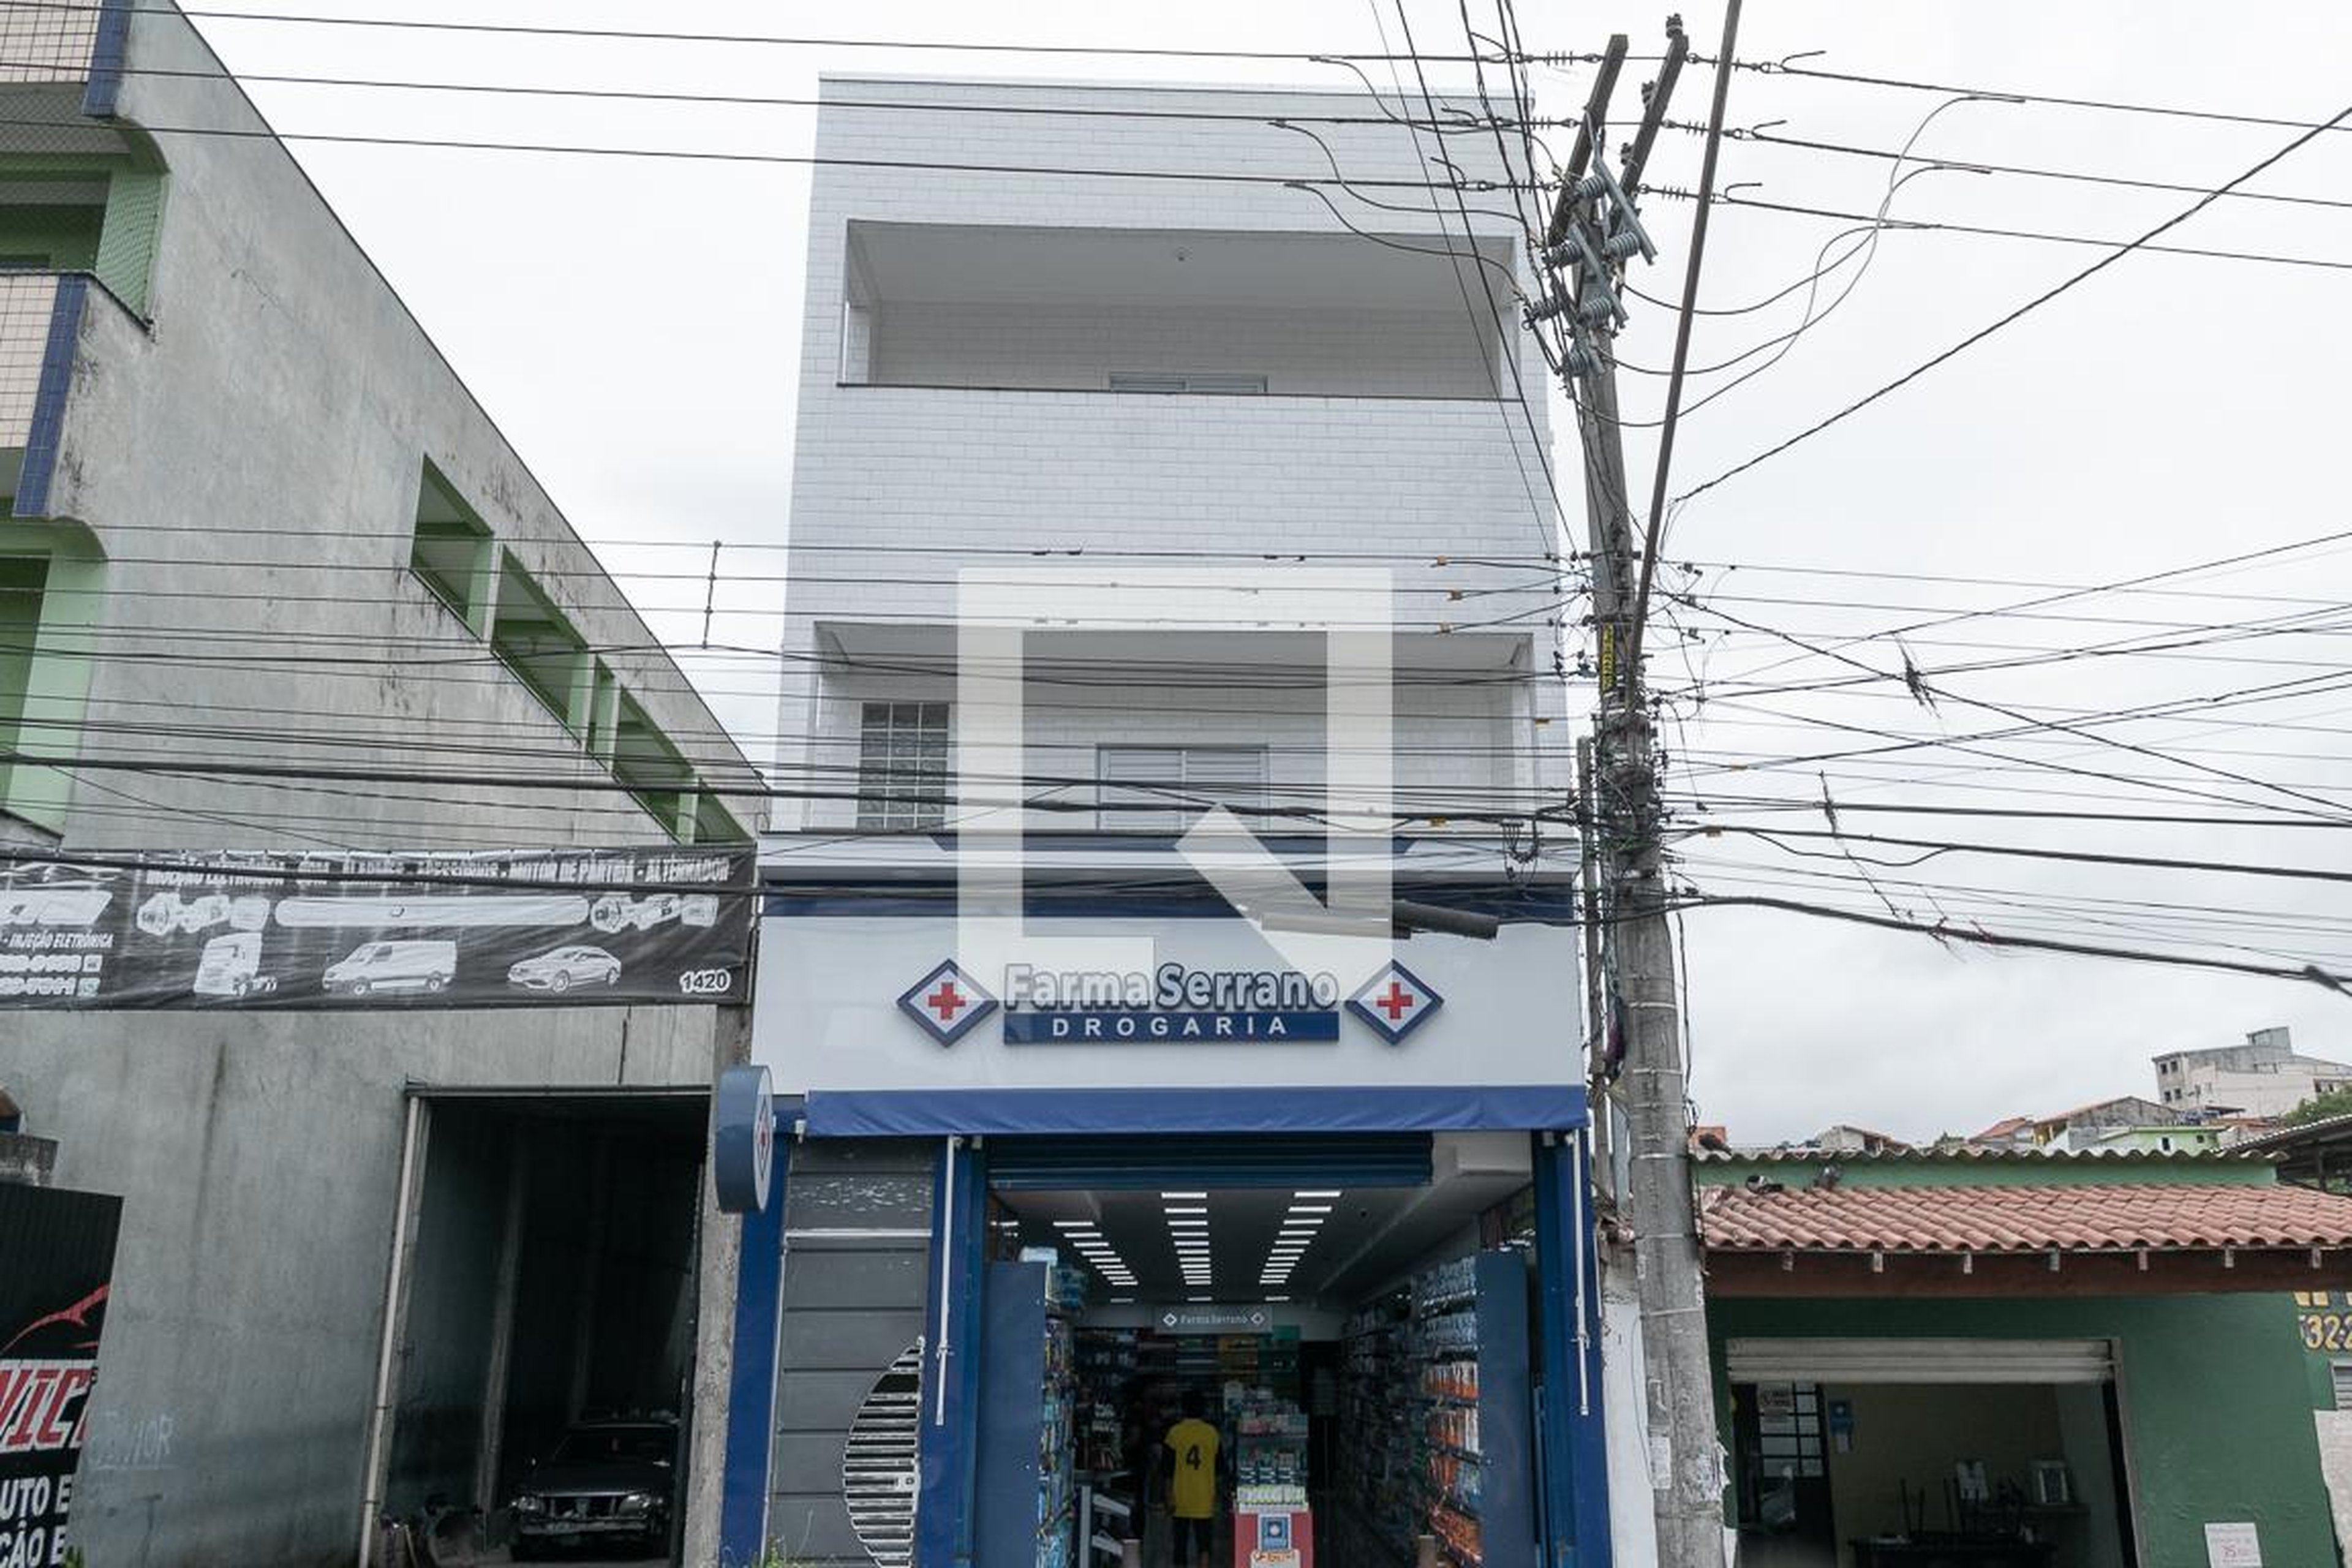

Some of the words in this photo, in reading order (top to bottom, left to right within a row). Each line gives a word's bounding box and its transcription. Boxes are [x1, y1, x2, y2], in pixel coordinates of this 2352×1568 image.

[681, 970, 729, 992] 1420
[1053, 1017, 1287, 1036] DROGARIA
[1186, 1444, 1202, 1470] 4
